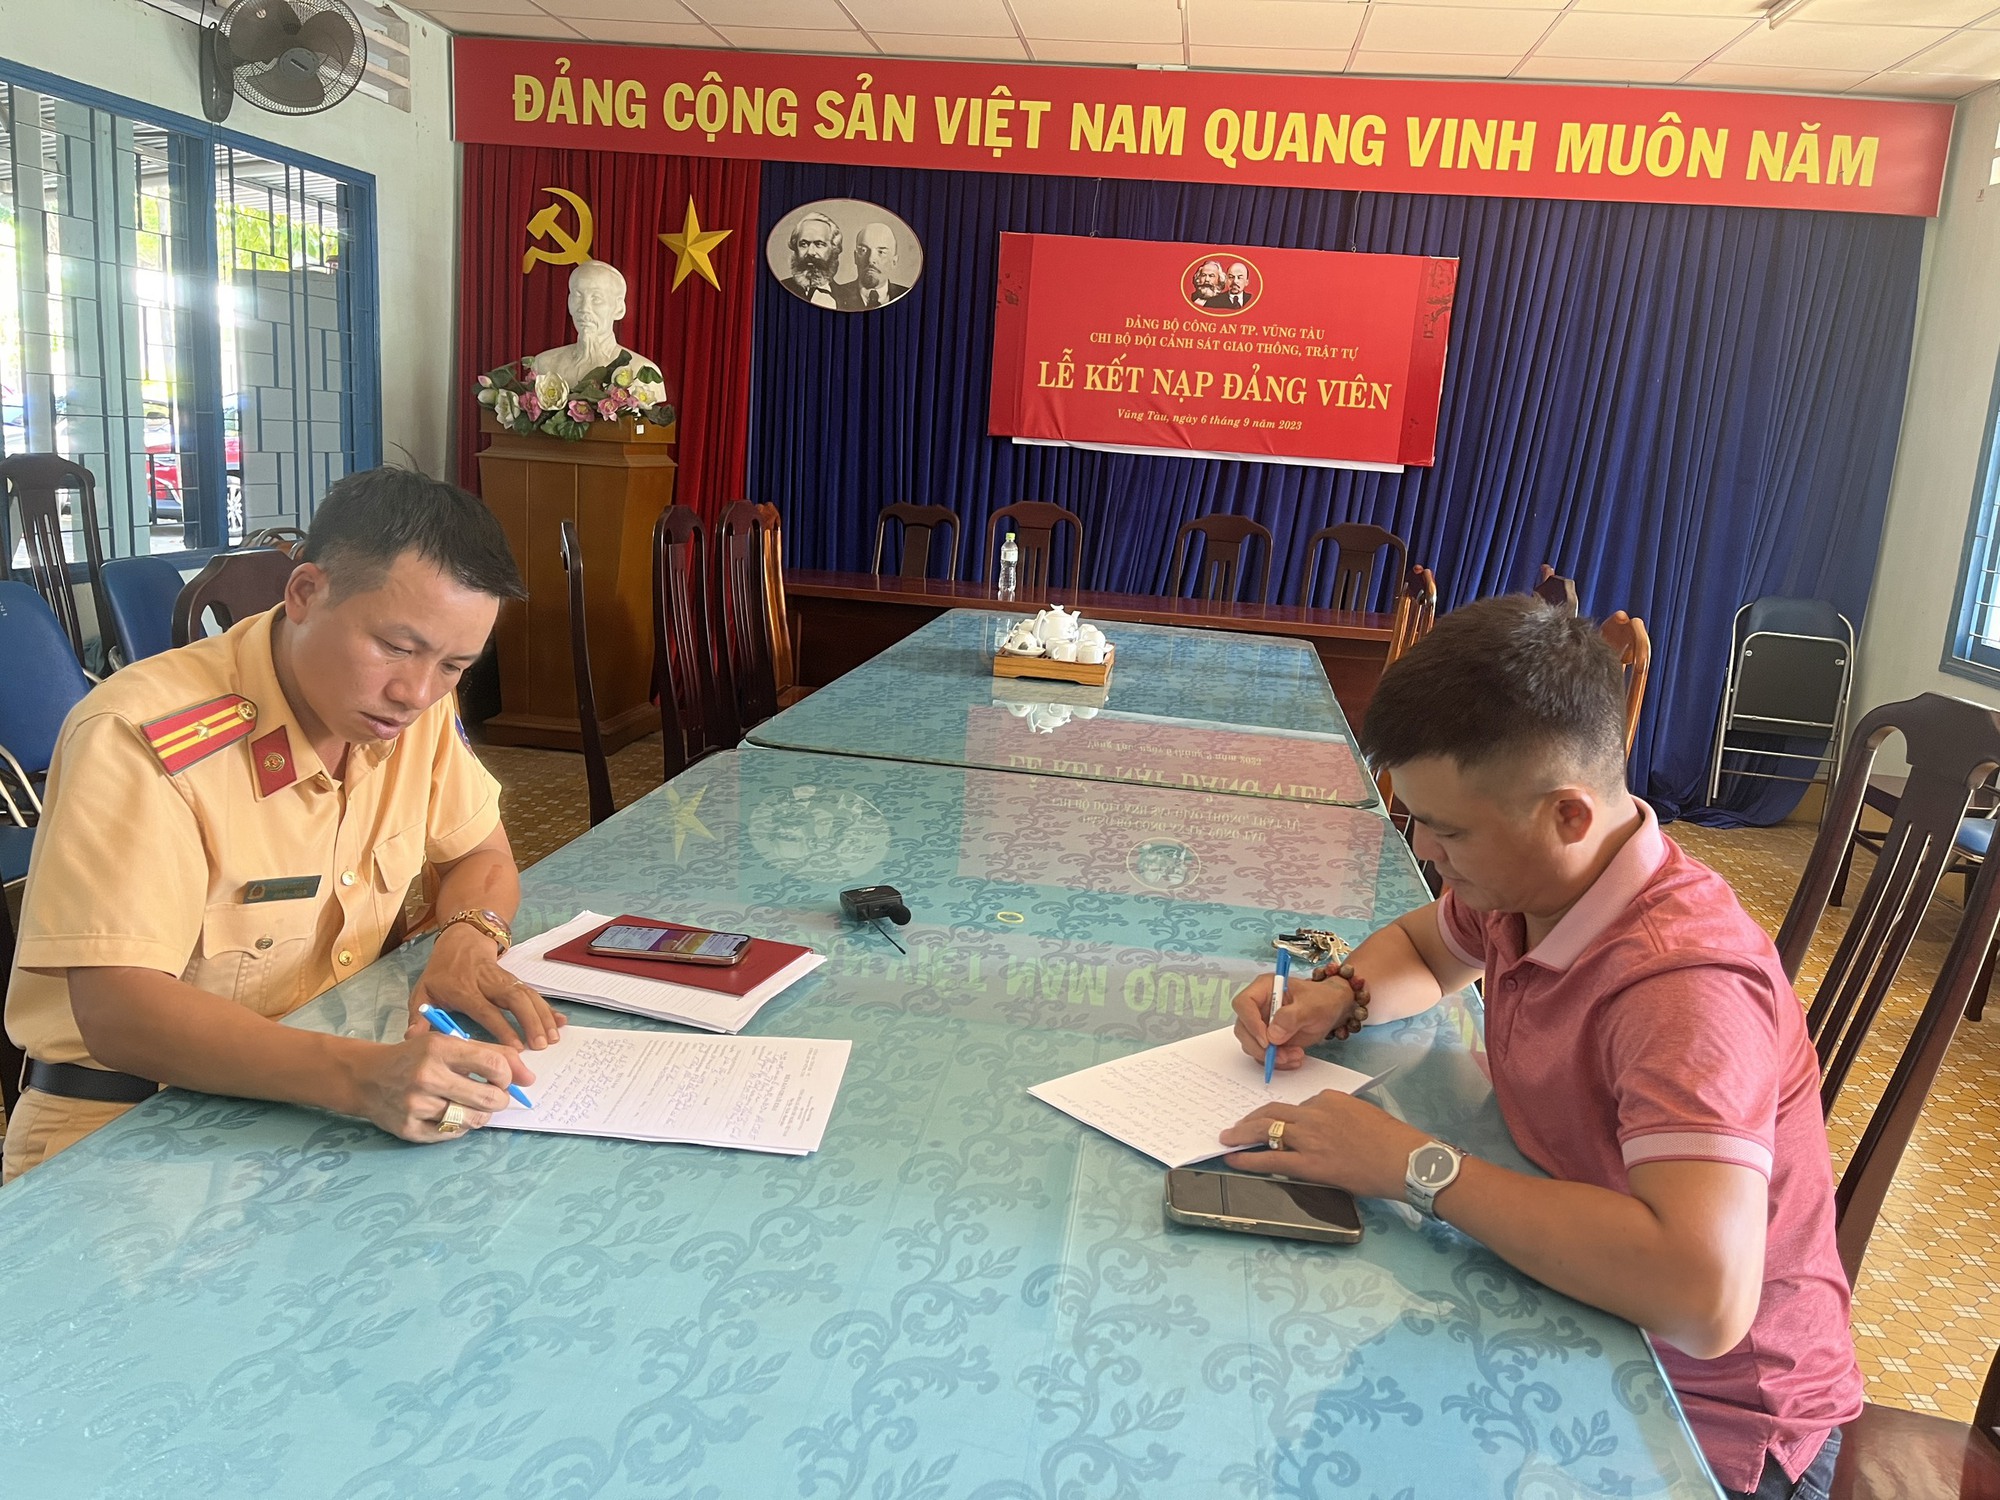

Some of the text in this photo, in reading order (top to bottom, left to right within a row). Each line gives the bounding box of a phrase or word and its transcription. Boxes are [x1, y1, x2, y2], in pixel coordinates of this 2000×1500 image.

[512, 57, 1880, 188] ĐẢNG CỘNG SẢN VIỆT NAM QUANG VINH MUÔN NĂM
[1125, 314, 1326, 340] ĐẢNG BỘ CÔNG AN TP. VŨNG TÀU
[1089, 331, 1359, 361] CHI BỘ ĐỘI CẢNH SÁT GIAO THÔNG, TRẬT TỰ
[1037, 348, 1393, 410] LỄ KẾT NẠP ĐẢNG VIÊN
[1117, 408, 1303, 431] Vũng Tàu, ngày 6 tháng 9 năm 2023
